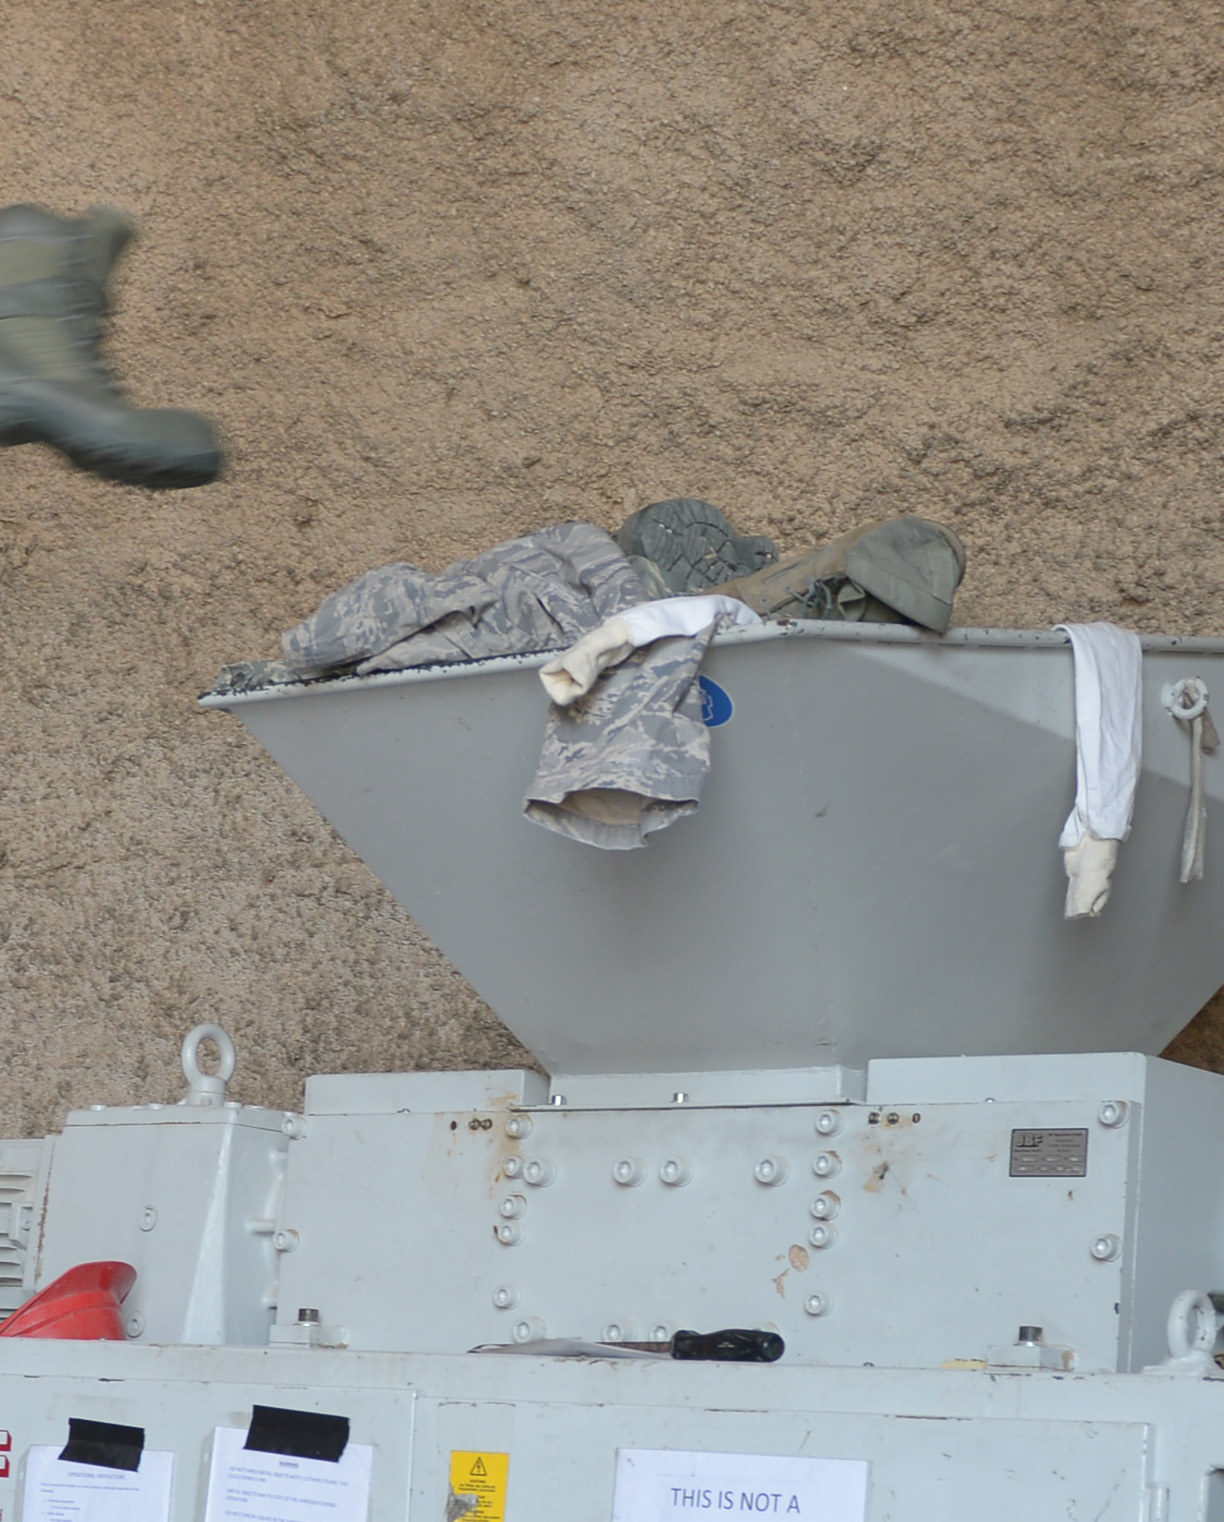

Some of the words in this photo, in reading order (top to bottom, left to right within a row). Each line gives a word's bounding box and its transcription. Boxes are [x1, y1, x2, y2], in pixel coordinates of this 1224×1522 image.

[670, 1488, 712, 1508] THIS
[718, 1490, 734, 1510] IS
[740, 1491, 783, 1512] NOT
[786, 1494, 801, 1514] A
